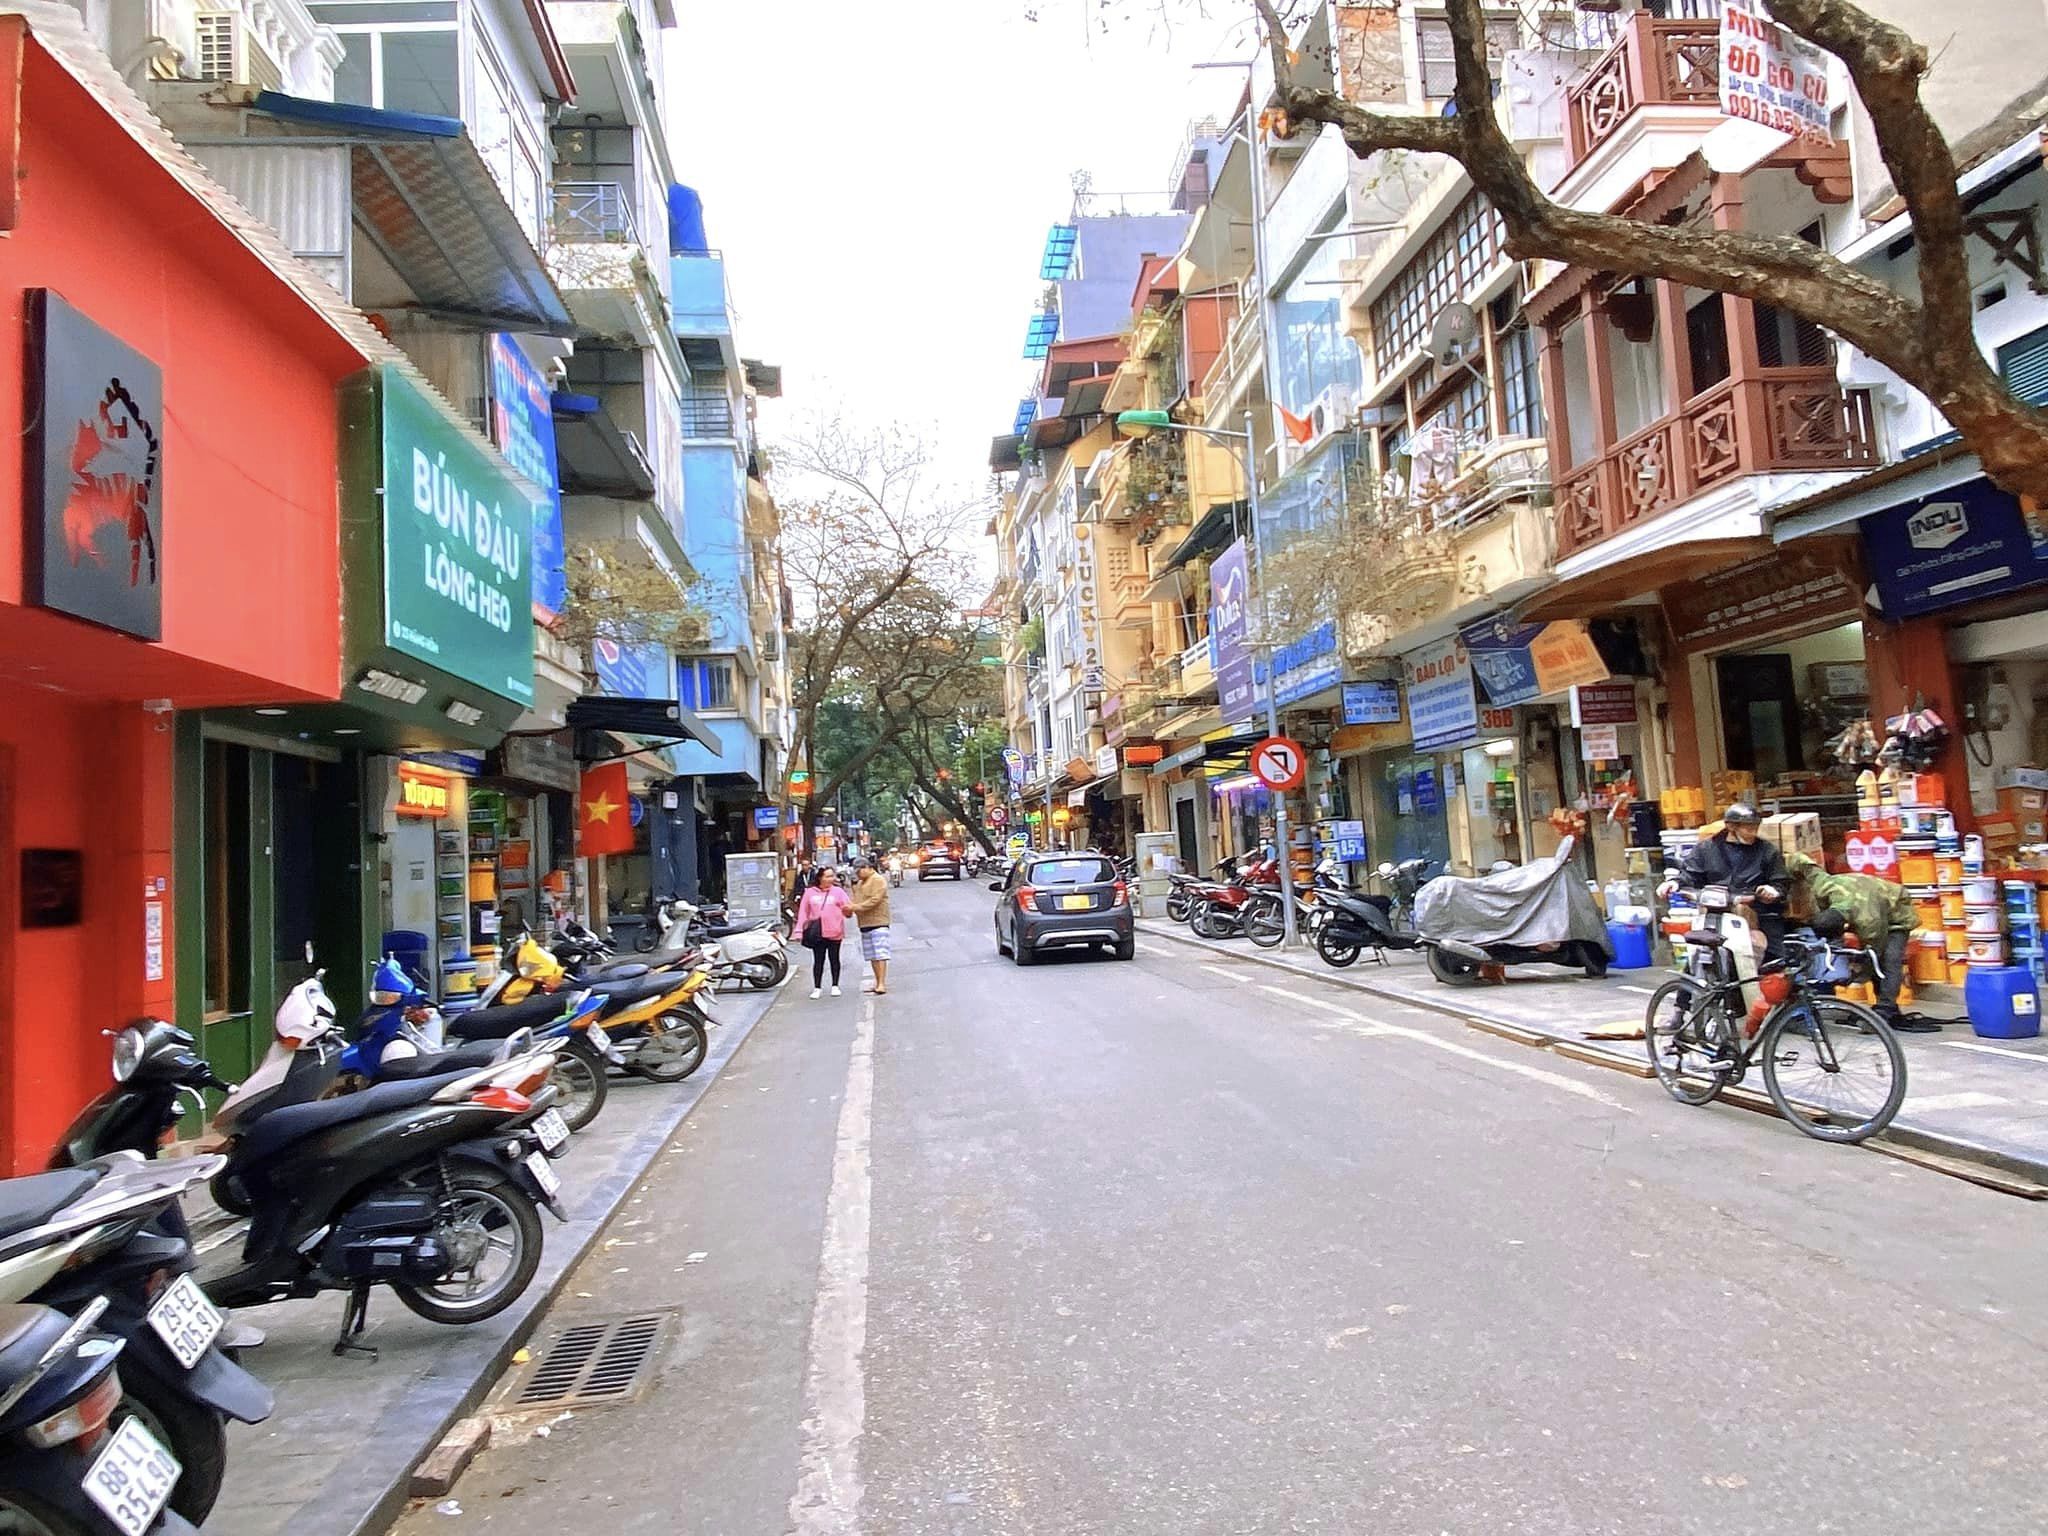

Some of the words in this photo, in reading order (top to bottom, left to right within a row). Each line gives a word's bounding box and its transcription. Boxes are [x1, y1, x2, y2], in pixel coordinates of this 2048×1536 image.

[413, 447, 470, 546] BÚN
[475, 500, 520, 584] ĐẬU
[425, 541, 477, 613] LÒNG
[479, 580, 511, 633] HEO
[1079, 546, 1096, 642] LUCKY
[1086, 647, 1097, 665] 2
